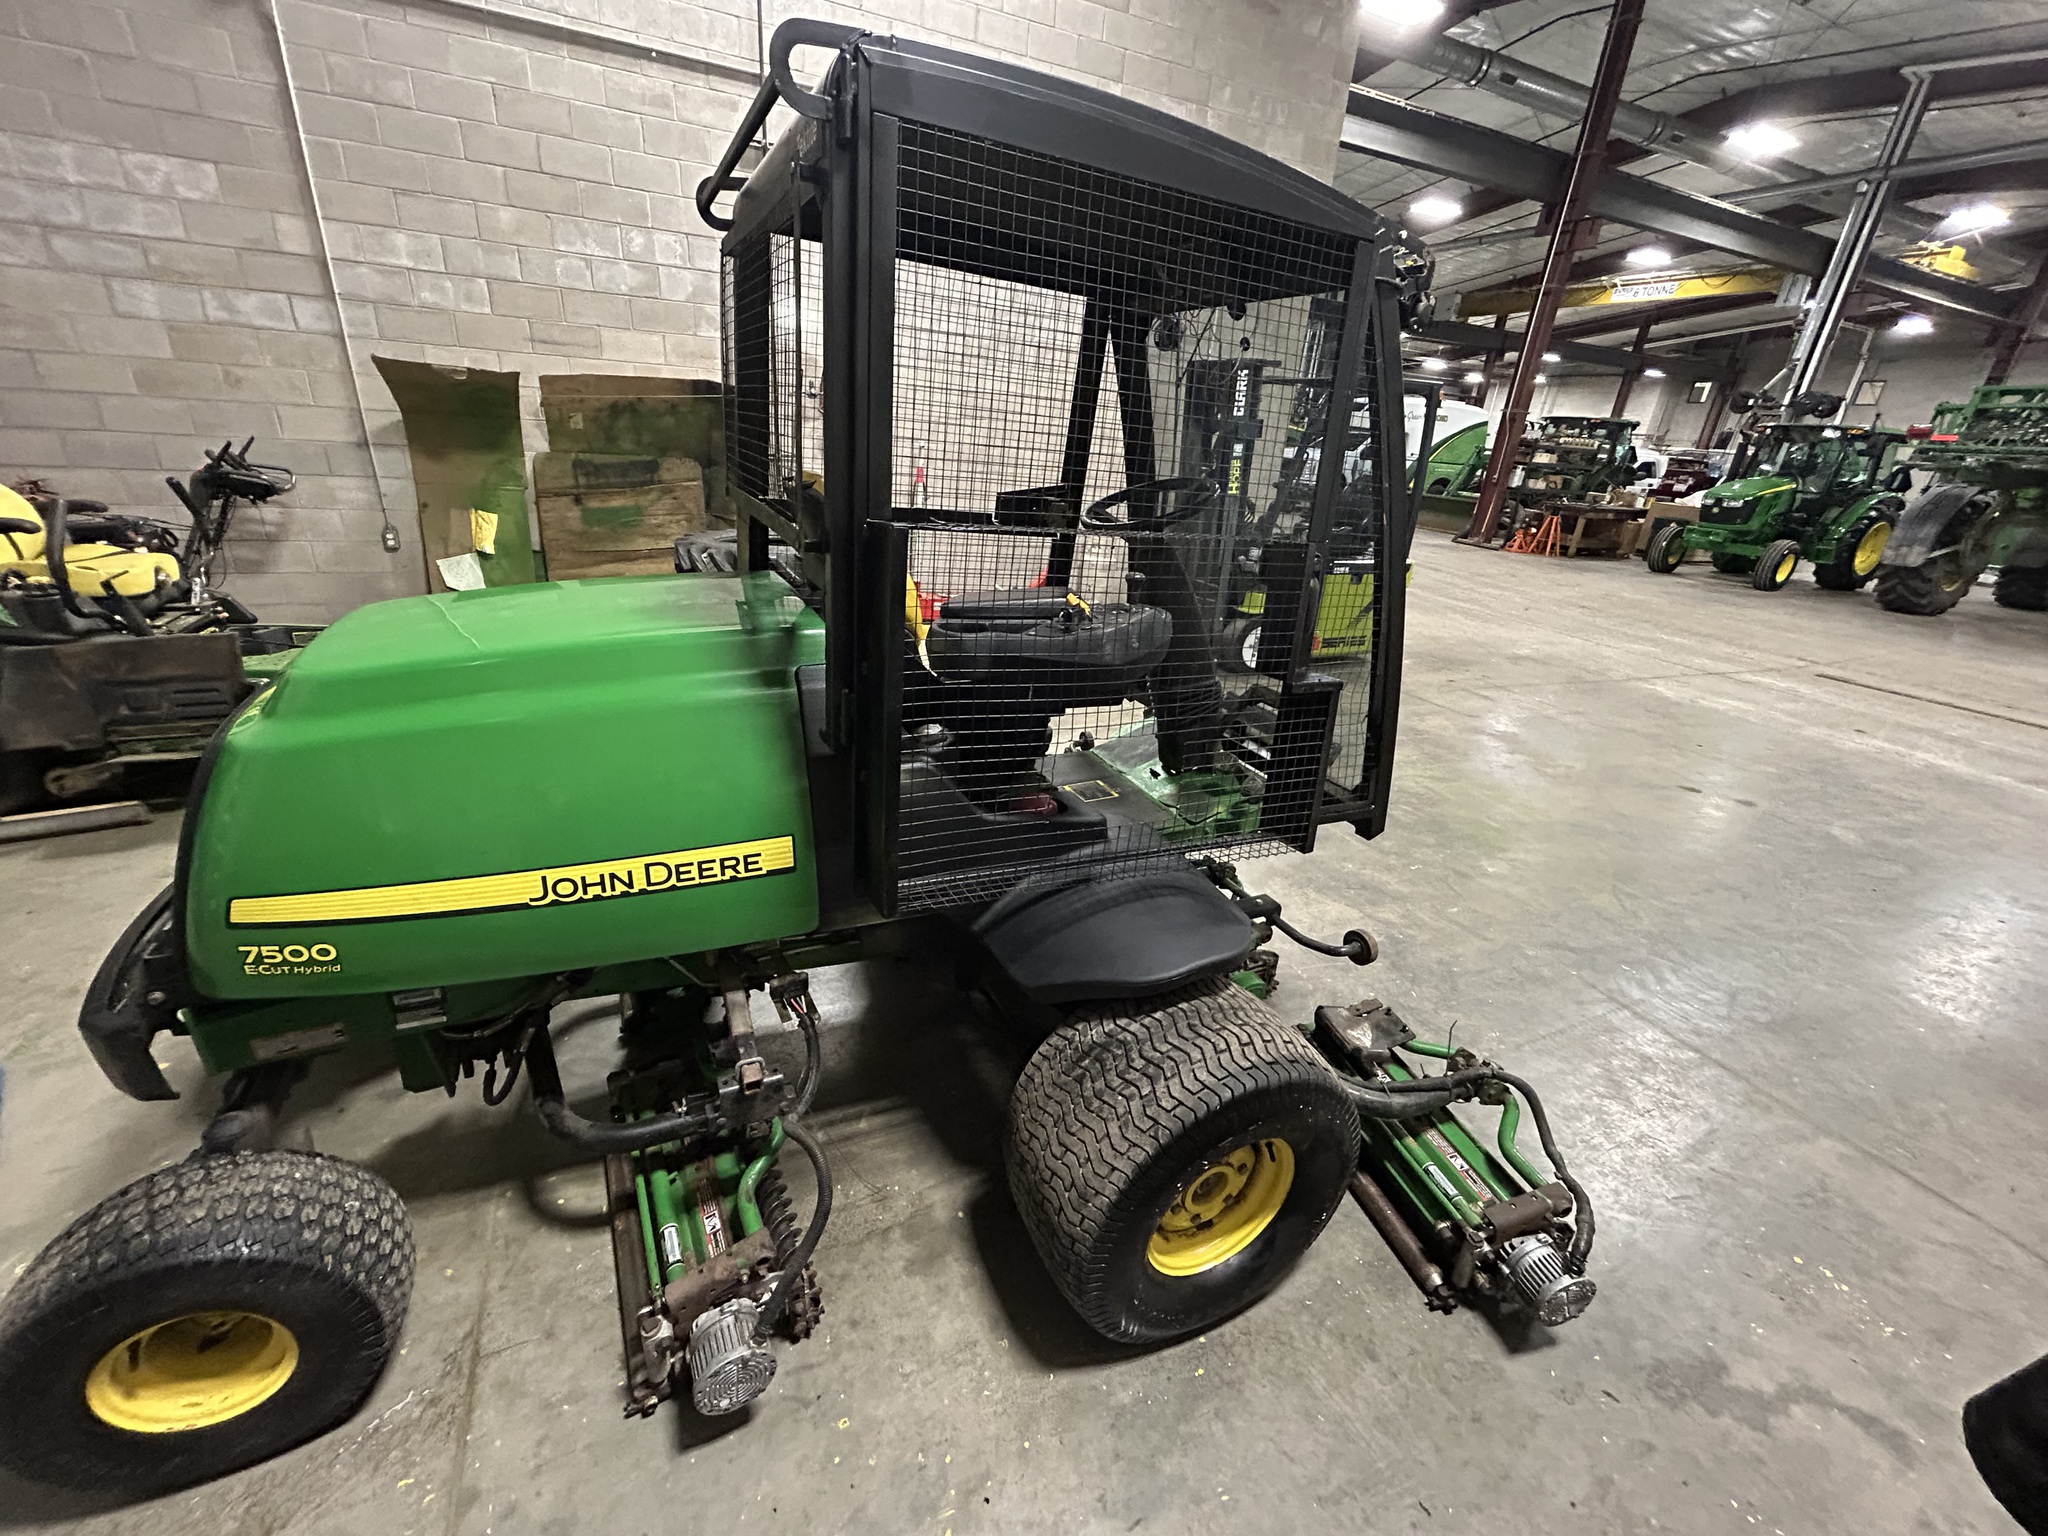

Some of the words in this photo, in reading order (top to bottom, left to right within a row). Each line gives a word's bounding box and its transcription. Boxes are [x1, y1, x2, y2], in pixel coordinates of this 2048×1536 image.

[1643, 284, 1676, 296] TONNE
[1233, 369, 1249, 417] CLARK
[528, 869, 635, 903] JOHN
[643, 852, 763, 888] DEERE
[237, 943, 338, 964] 7500
[293, 963, 342, 976] Hybrid
